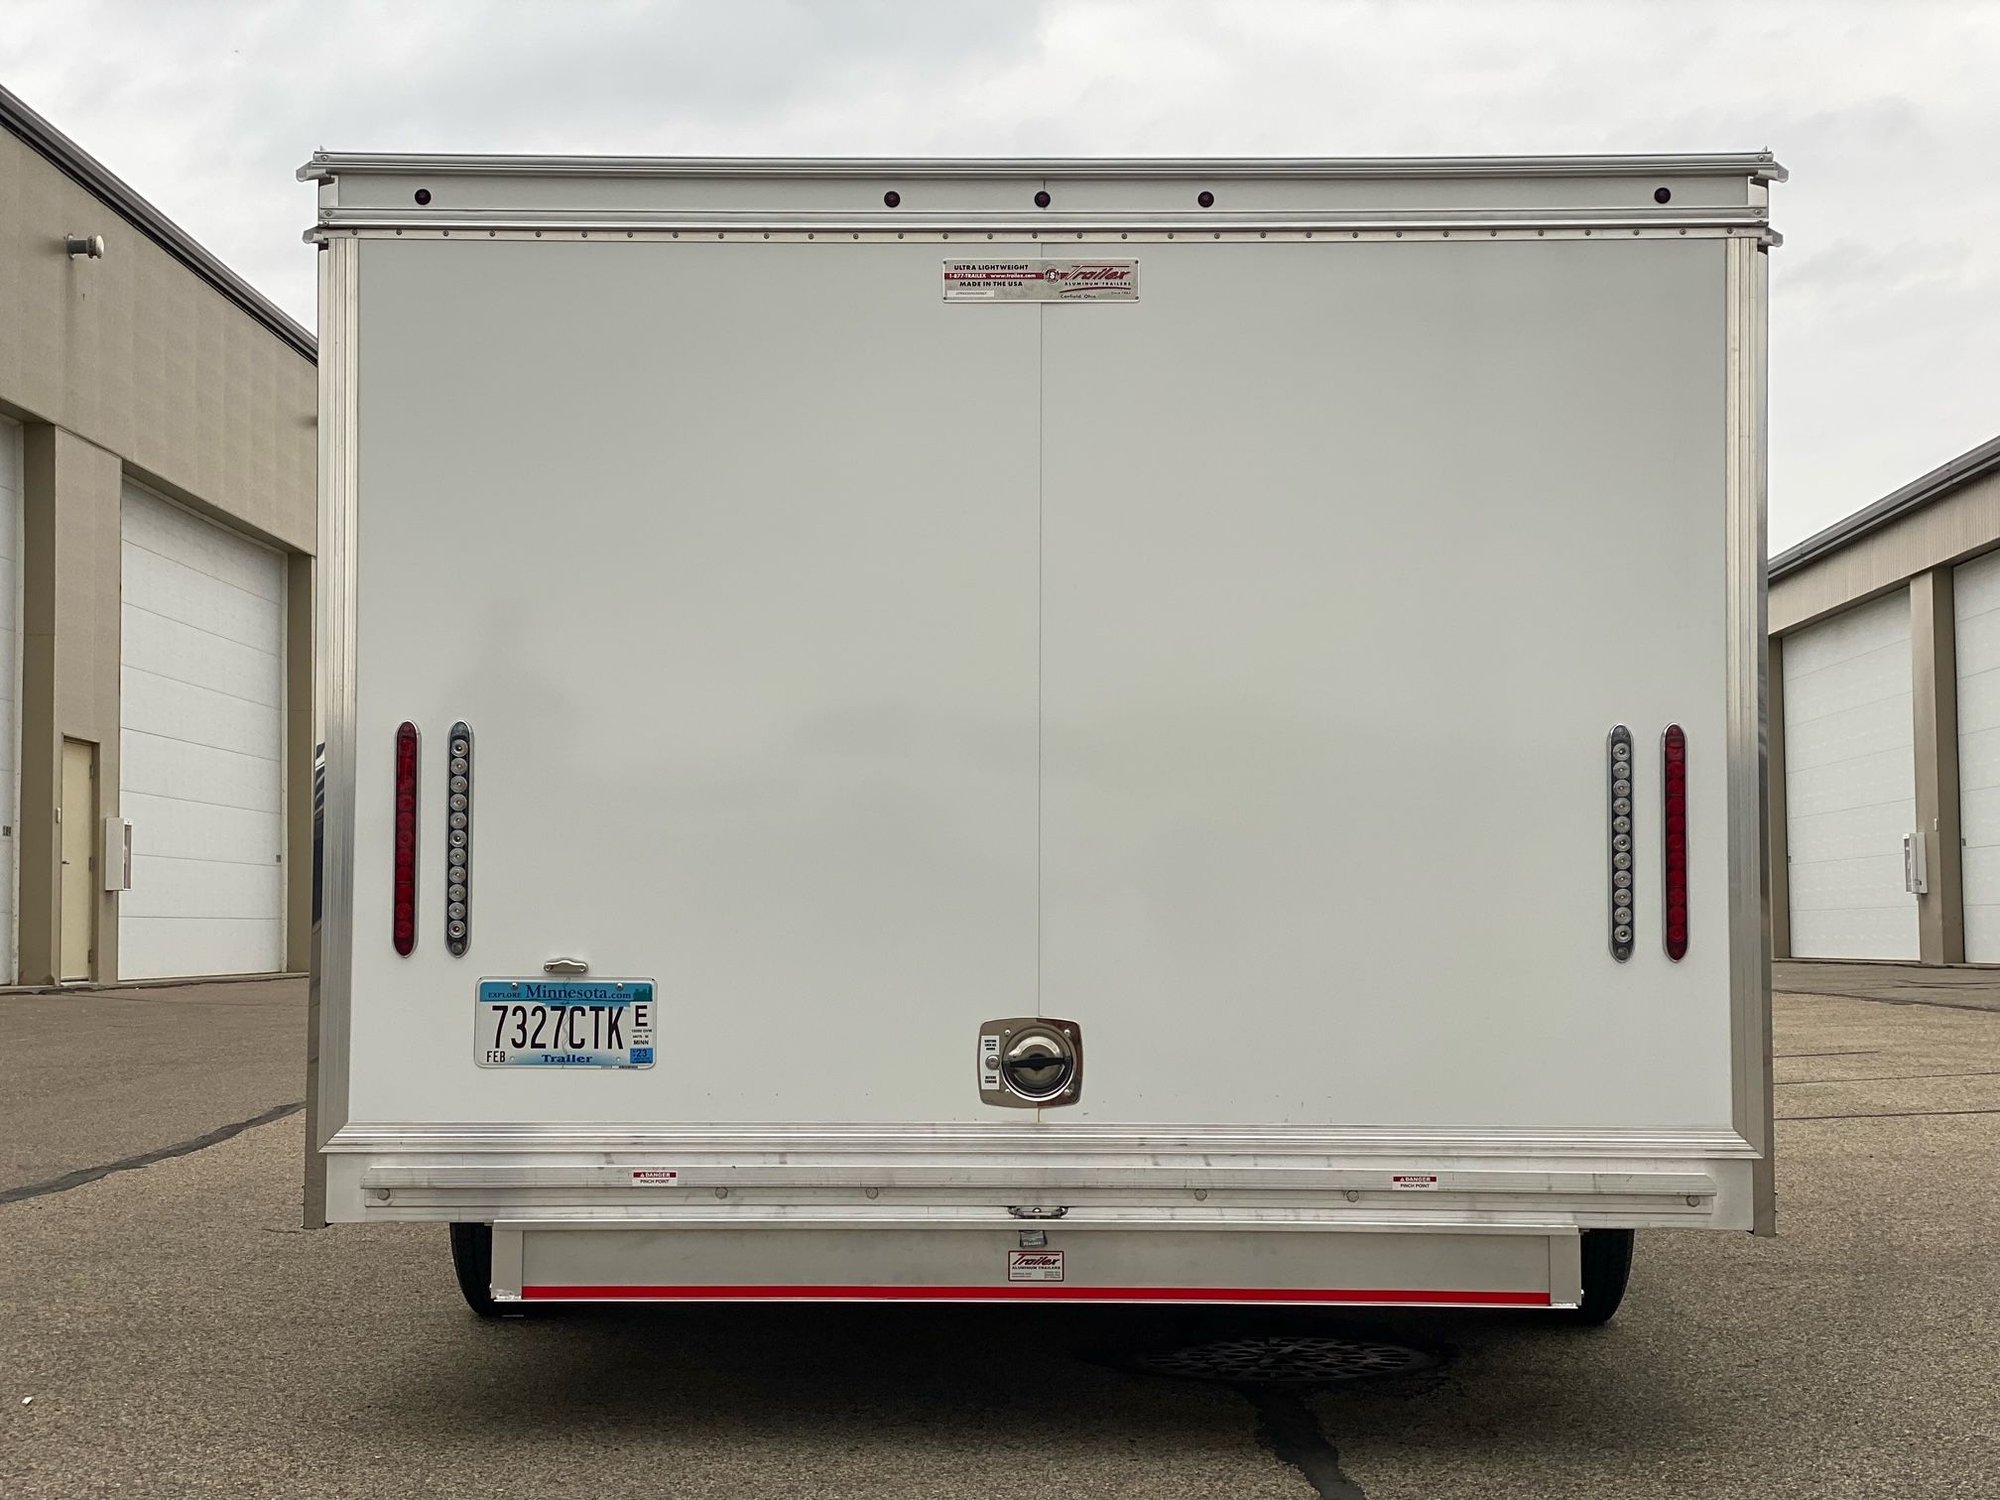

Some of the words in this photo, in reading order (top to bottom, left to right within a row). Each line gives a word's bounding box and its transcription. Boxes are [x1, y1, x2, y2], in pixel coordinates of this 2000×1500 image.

[526, 984, 632, 999] Minnesota.com
[635, 1005, 648, 1027] E
[491, 1005, 624, 1050] 7327CTK
[486, 1050, 506, 1063] FEB
[541, 1054, 592, 1063] Trailer
[636, 1048, 648, 1058] 23
